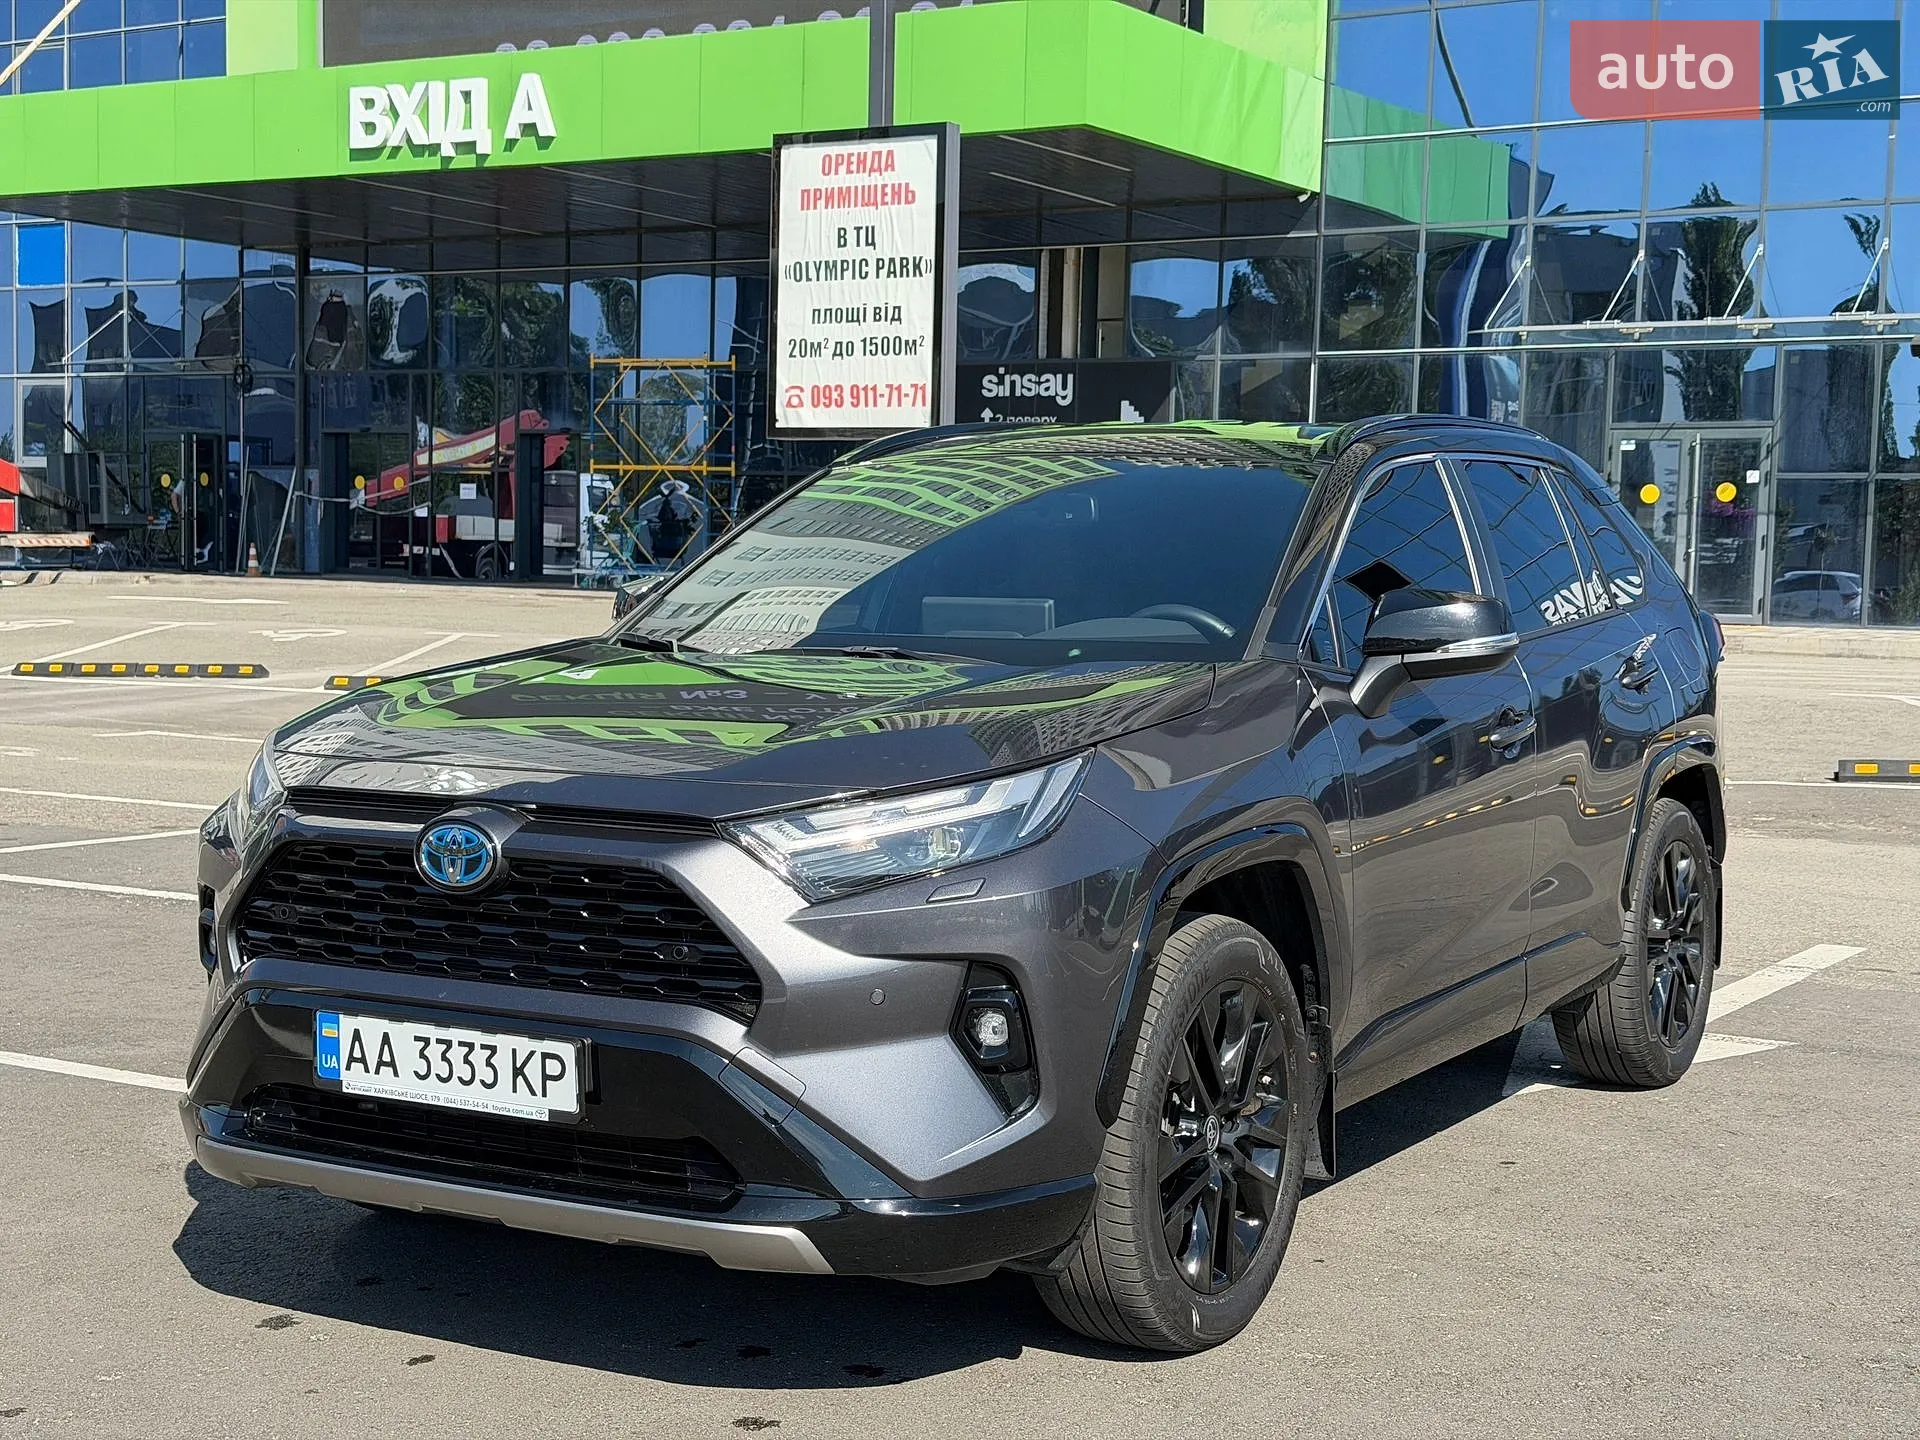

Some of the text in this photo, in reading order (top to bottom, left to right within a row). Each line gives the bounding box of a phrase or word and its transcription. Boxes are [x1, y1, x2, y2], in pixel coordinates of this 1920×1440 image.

[349, 72, 557, 158] ВХІД А
[821, 149, 895, 177] ОРЕНДА
[800, 182, 917, 212] ПРИМІЩЕНЬ
[837, 225, 876, 251] В ТЦ
[784, 255, 933, 283] «OLYMPIC PARK»
[811, 302, 902, 326] площі від
[832, 339, 854, 361] до
[810, 383, 927, 408] 093 911-71-71
[981, 366, 1074, 407] sinsay
[322, 1053, 338, 1069] UA
[345, 1028, 567, 1098] AA 3333 KP
